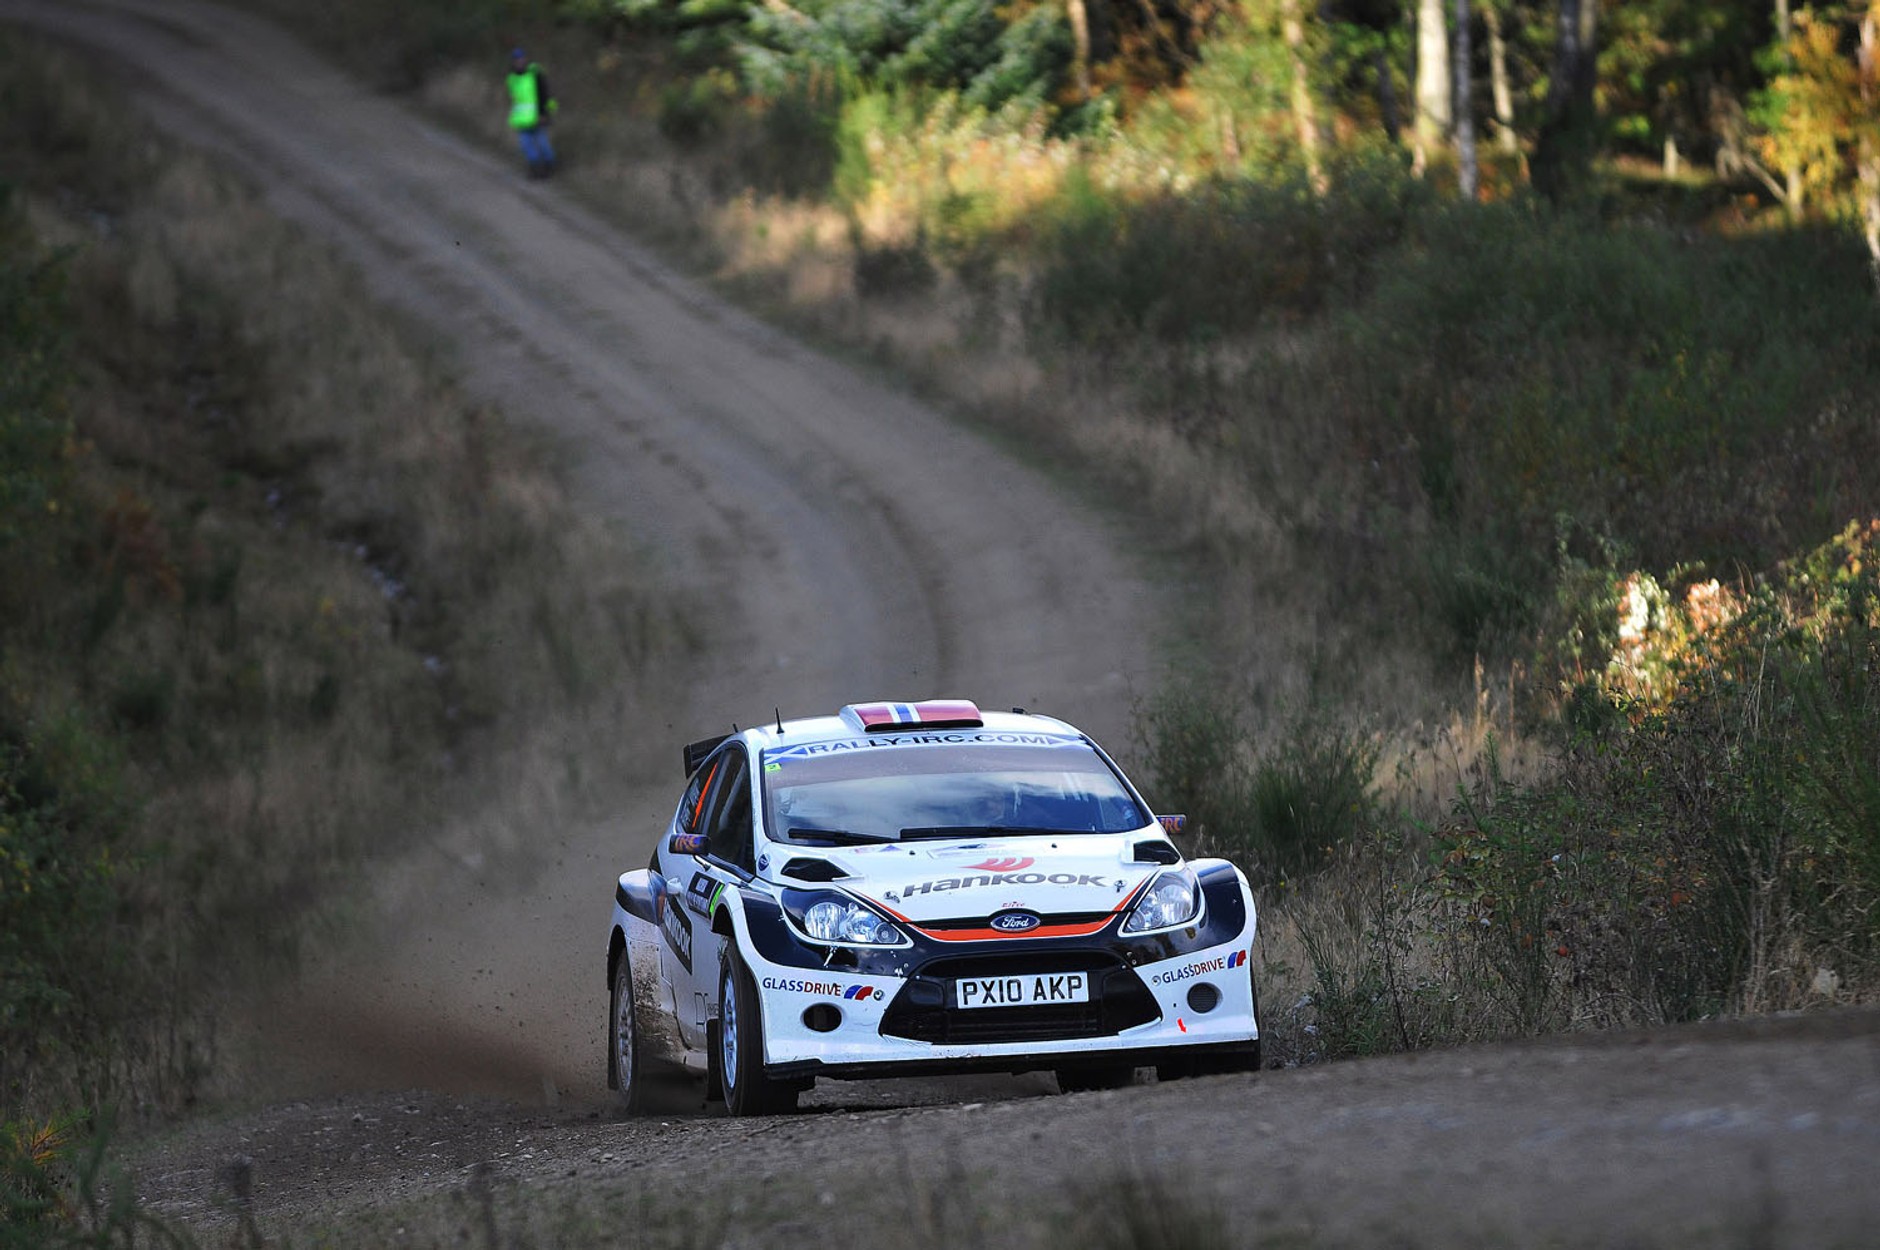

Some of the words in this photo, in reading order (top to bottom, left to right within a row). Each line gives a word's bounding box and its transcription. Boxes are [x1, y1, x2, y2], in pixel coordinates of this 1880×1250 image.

[808, 734, 1047, 754] RALLY-IRC.COM
[1001, 916, 1029, 928] Ford
[1162, 957, 1225, 984] GLASSDRIVE
[762, 977, 842, 997] GLASSDRIVE
[962, 979, 1023, 1006] PX10
[1032, 975, 1083, 1002] AKP
